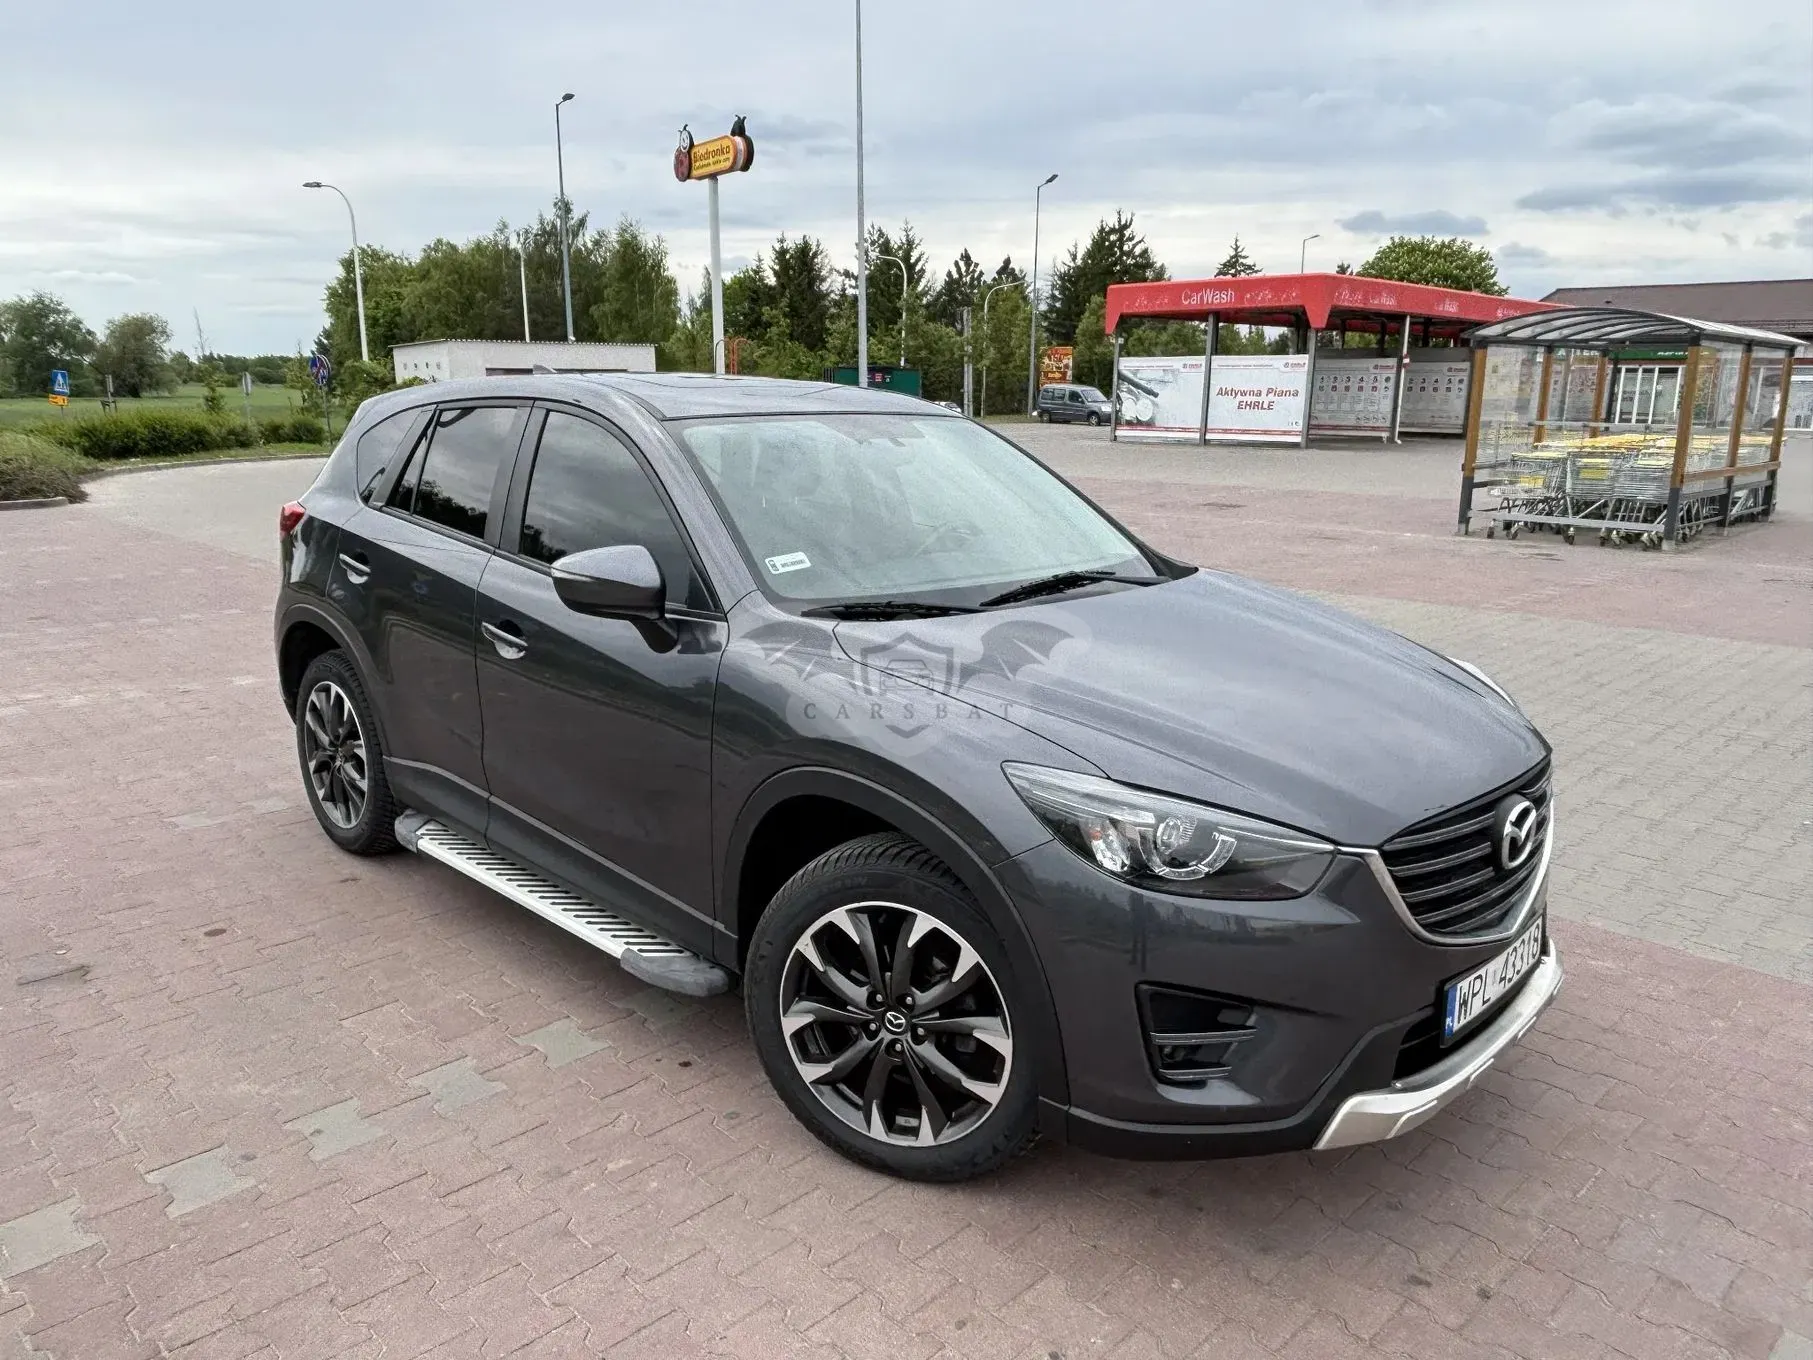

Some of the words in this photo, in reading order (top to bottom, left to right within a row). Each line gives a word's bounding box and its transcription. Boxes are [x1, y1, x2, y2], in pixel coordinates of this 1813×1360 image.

[693, 144, 731, 164] Biedronka
[1181, 288, 1235, 305] CarWash
[1216, 387, 1262, 400] Aktywna
[1265, 387, 1300, 398] Piana
[1237, 400, 1275, 411] EHRLE
[1457, 968, 1492, 1025] WPL
[1498, 922, 1540, 989] 43318
